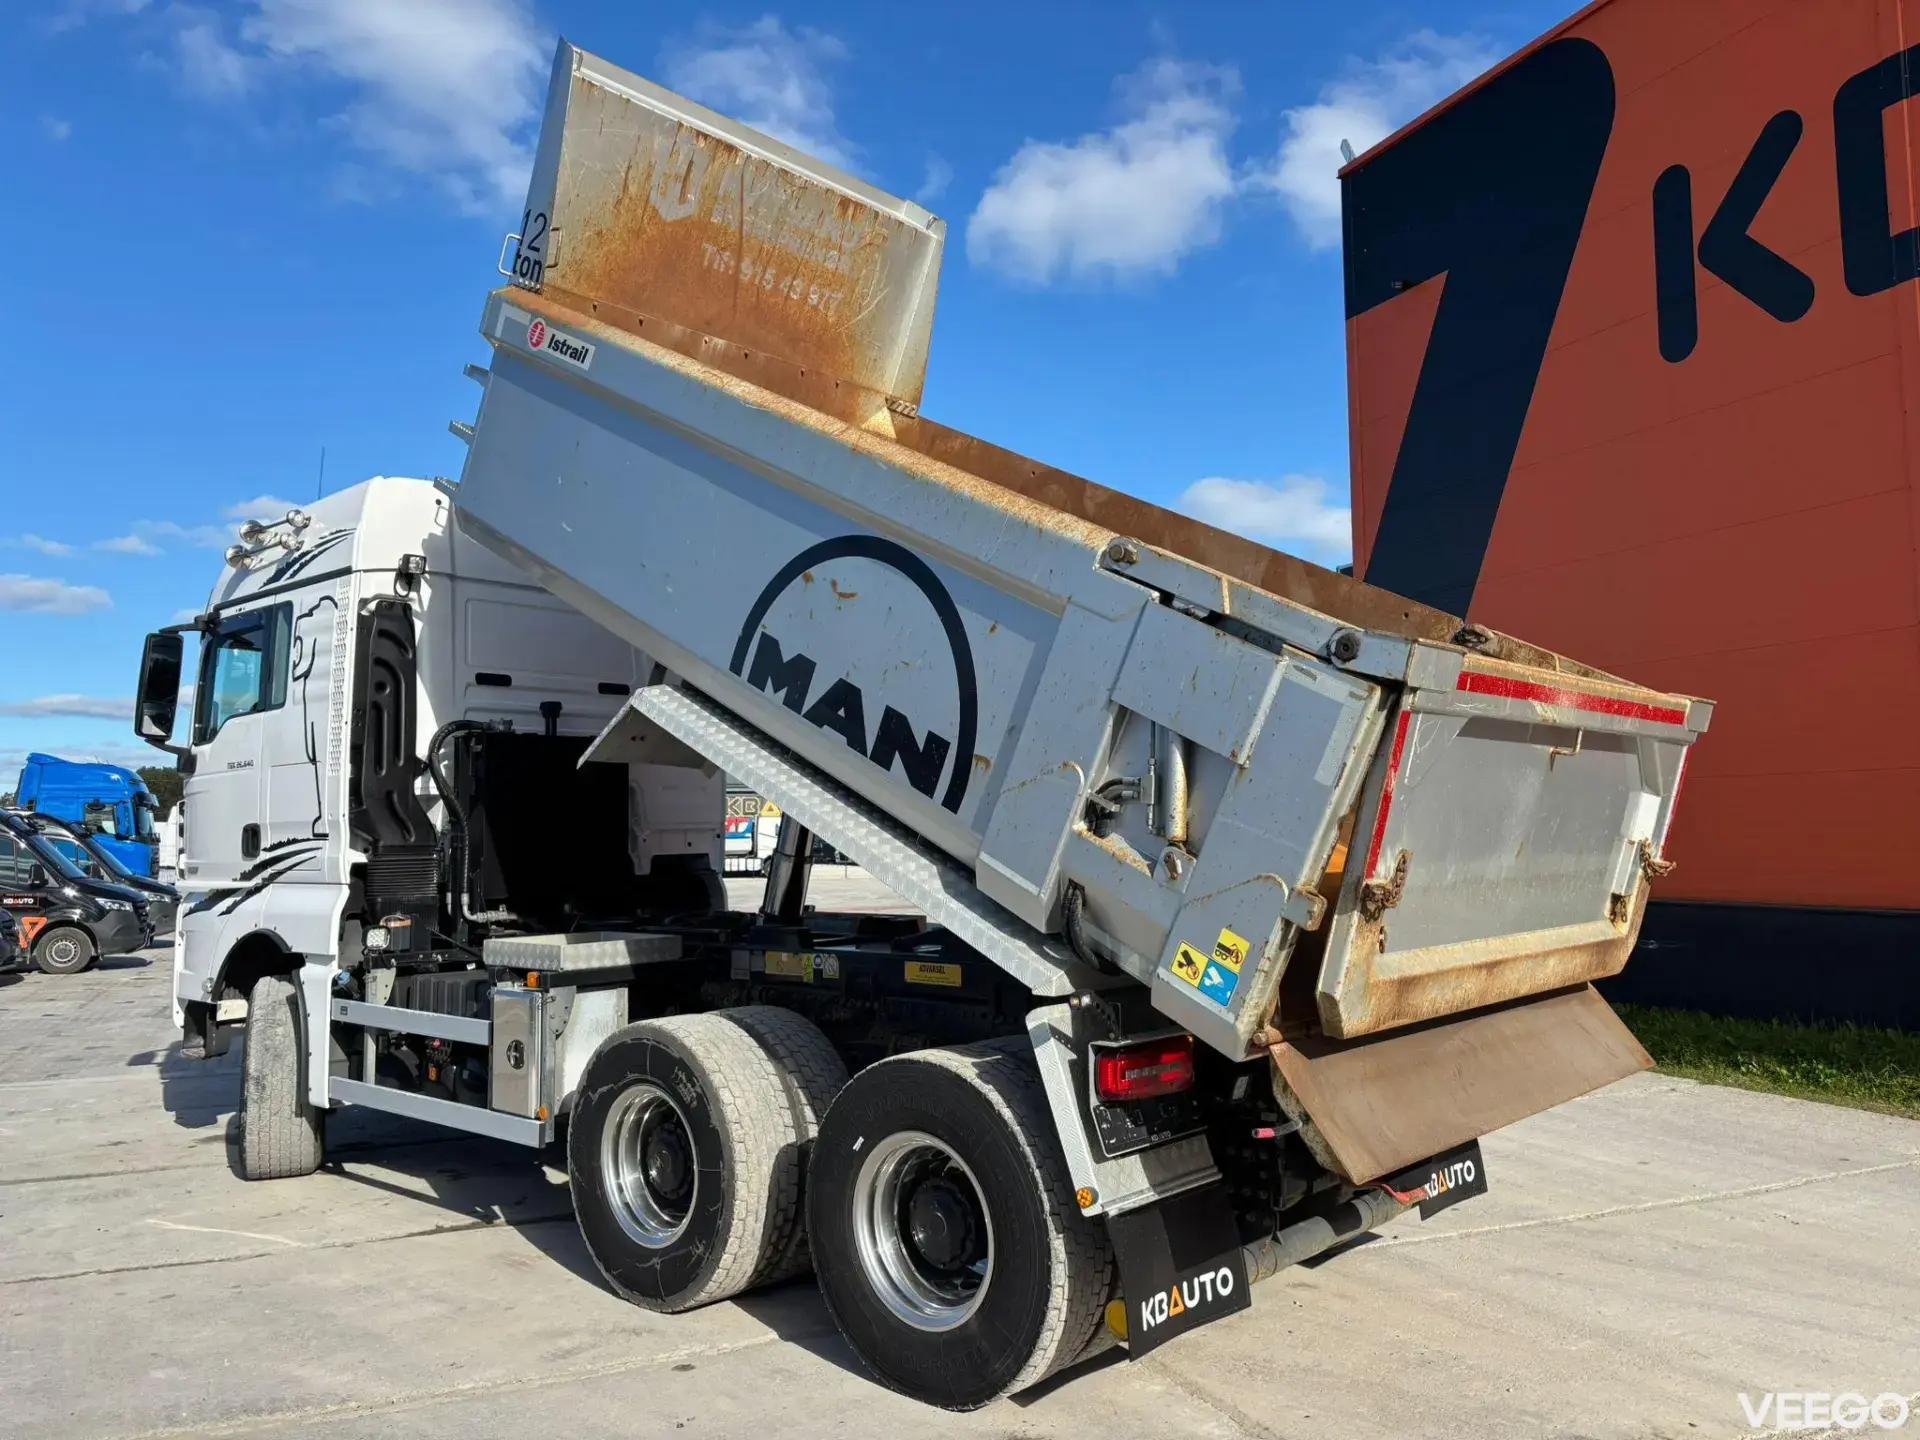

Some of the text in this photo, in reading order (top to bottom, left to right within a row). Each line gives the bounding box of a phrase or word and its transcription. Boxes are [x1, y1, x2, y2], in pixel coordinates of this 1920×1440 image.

[519, 208, 548, 253] 12
[512, 248, 543, 283] ton
[779, 275, 804, 301] 43
[547, 333, 590, 365] Istrail
[747, 631, 951, 799] MAN
[1141, 1266, 1234, 1331] KBAUTO
